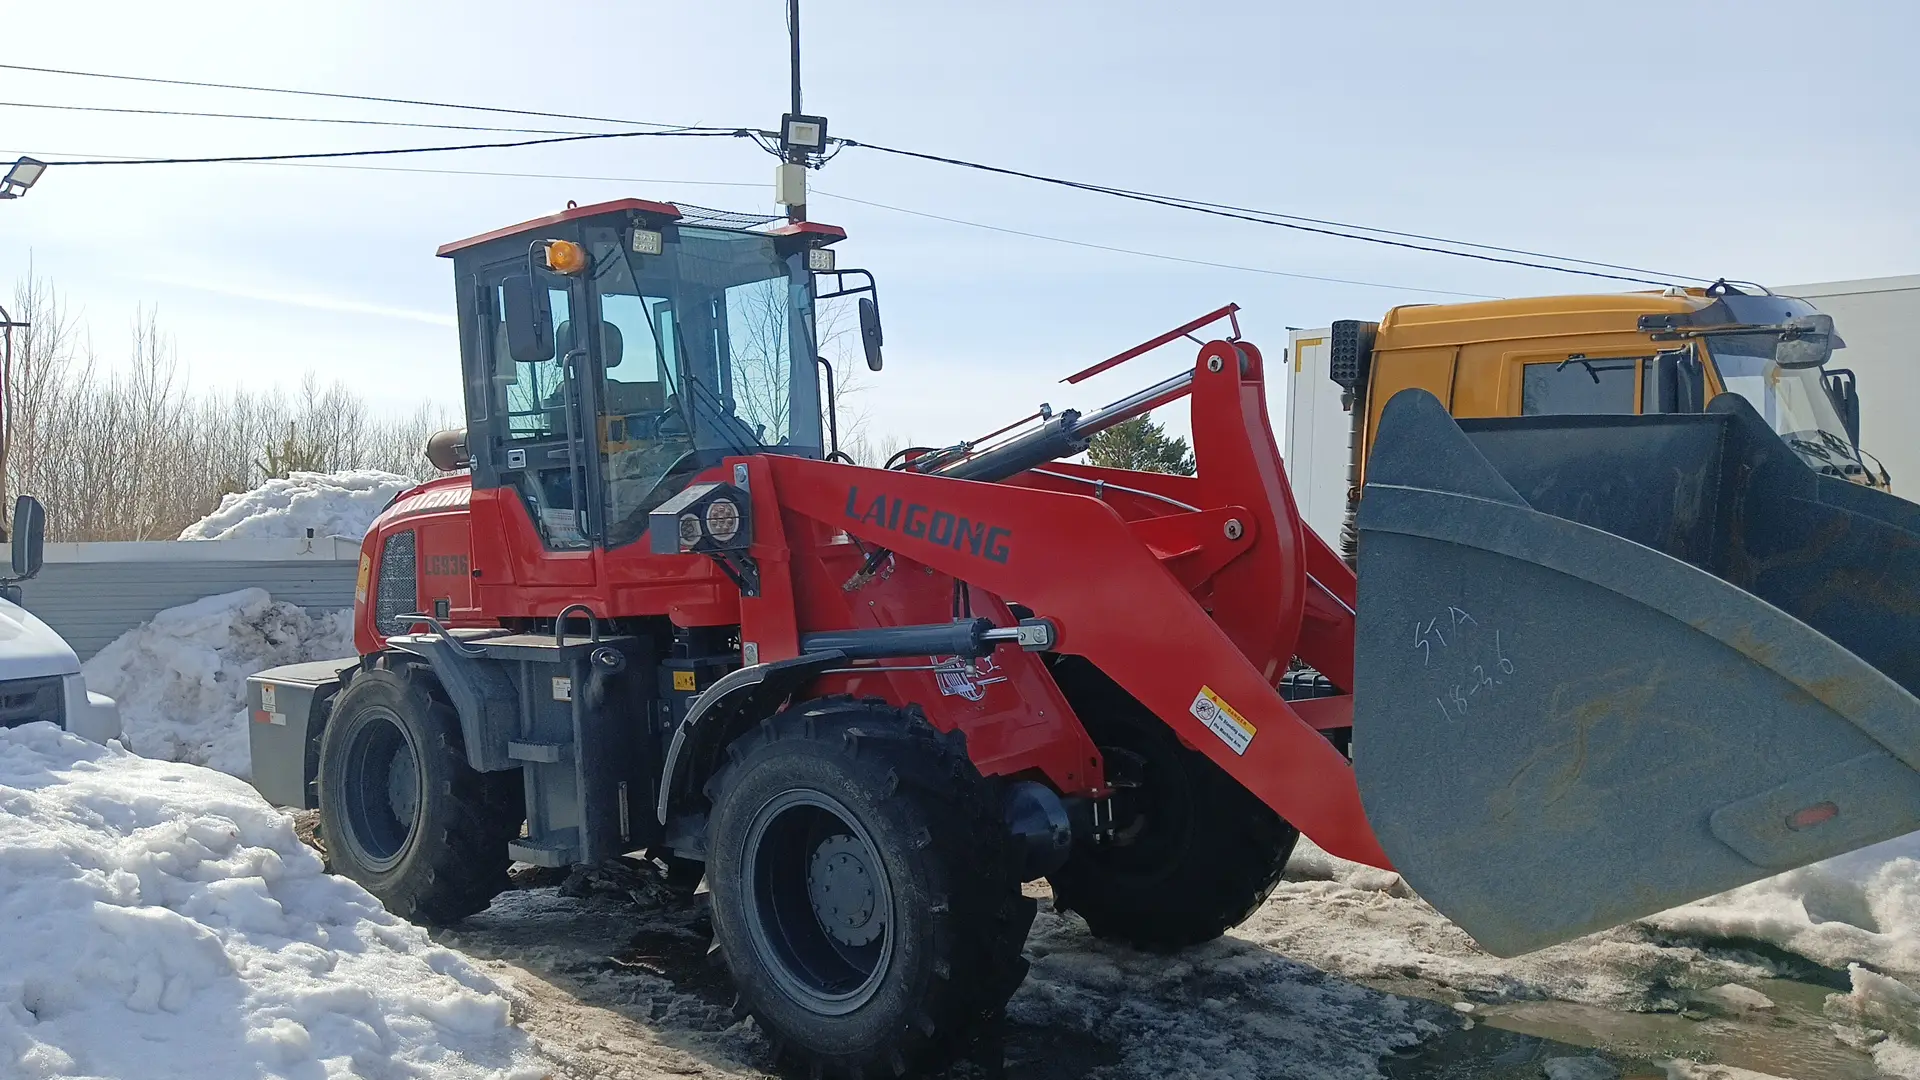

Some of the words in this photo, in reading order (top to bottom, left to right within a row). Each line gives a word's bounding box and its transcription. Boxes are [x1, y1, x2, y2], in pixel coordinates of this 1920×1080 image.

[845, 486, 1012, 565] LAIGONG
[424, 554, 468, 575] LG936
[1227, 707, 1247, 726] DANGER
[1219, 728, 1234, 742] Machine
[1233, 740, 1241, 748] Arm
[1223, 719, 1238, 735] Standing
[1238, 732, 1249, 742] under
